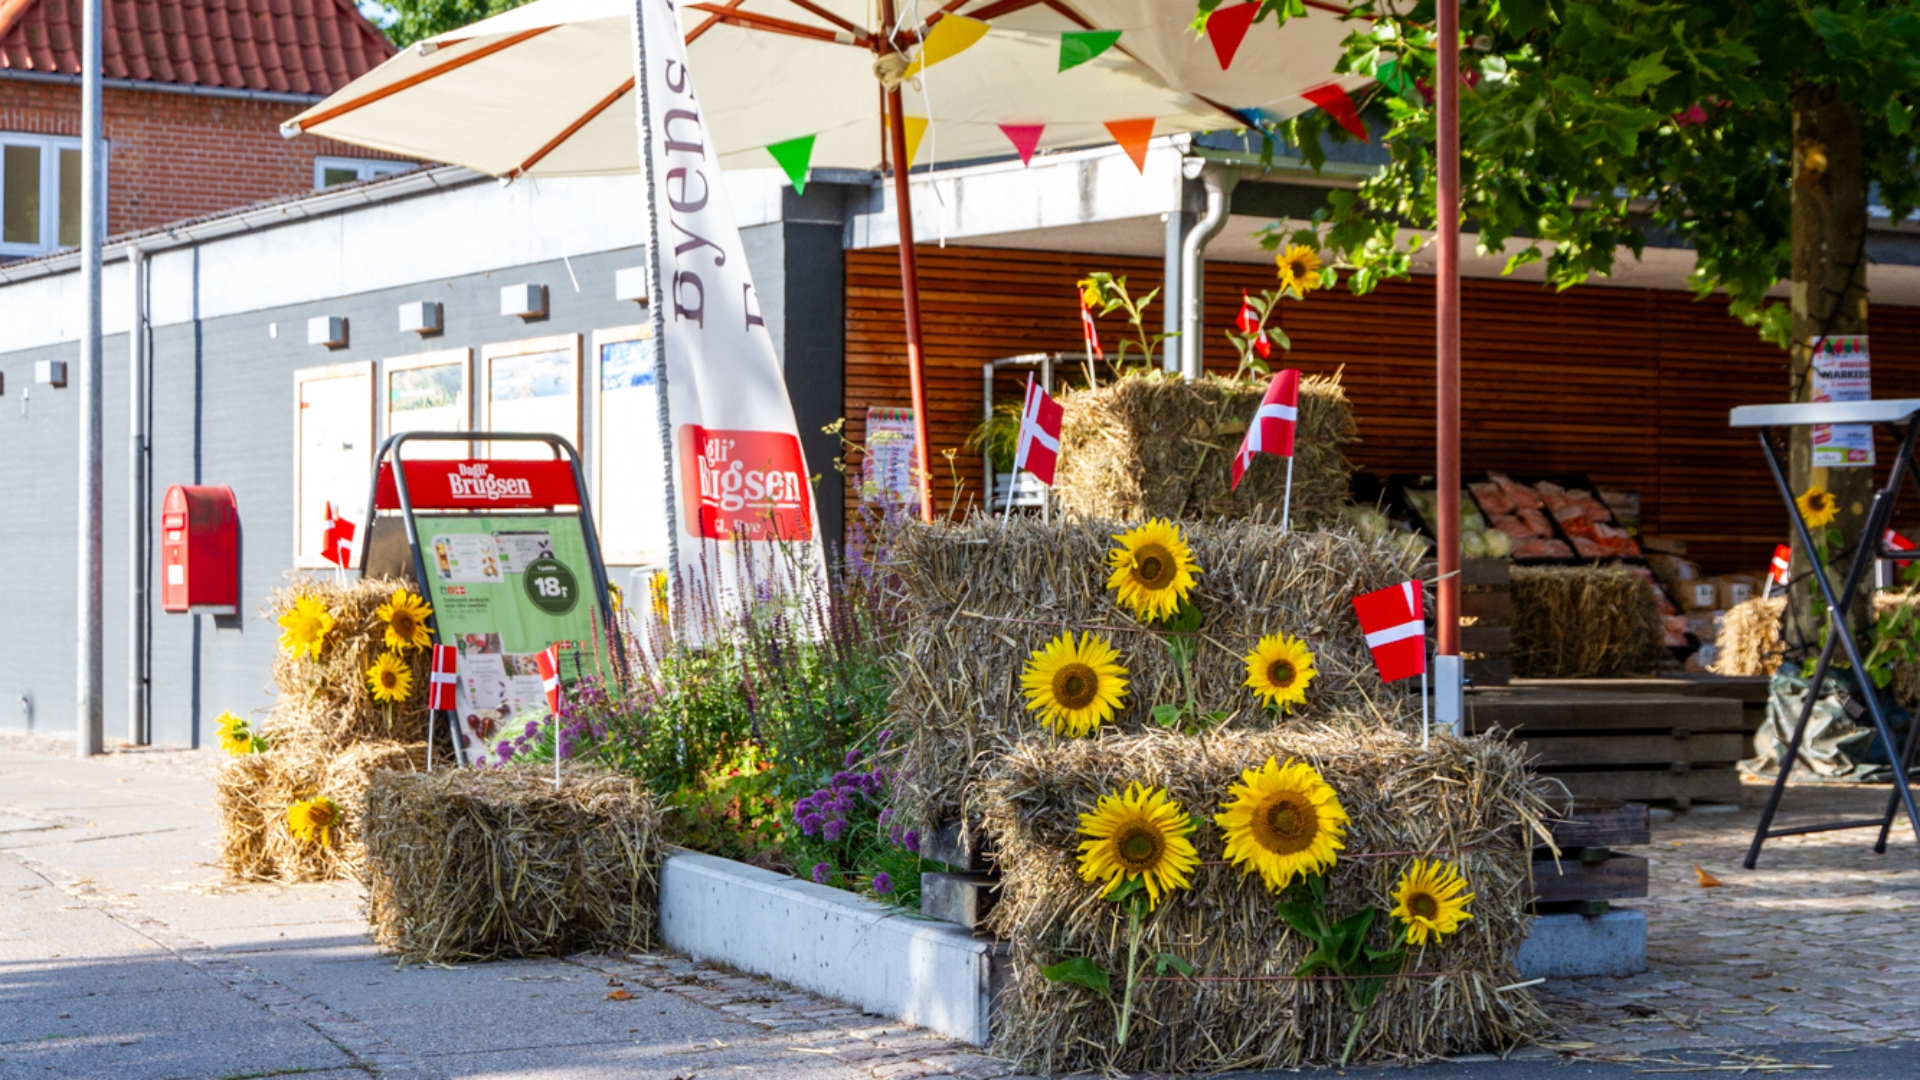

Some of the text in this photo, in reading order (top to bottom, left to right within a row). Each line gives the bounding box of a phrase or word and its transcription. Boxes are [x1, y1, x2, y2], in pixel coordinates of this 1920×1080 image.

[703, 436, 735, 467] gli'
[457, 463, 489, 479] Dagli'
[697, 460, 801, 511] Bgsen
[448, 473, 532, 500] Brugsen
